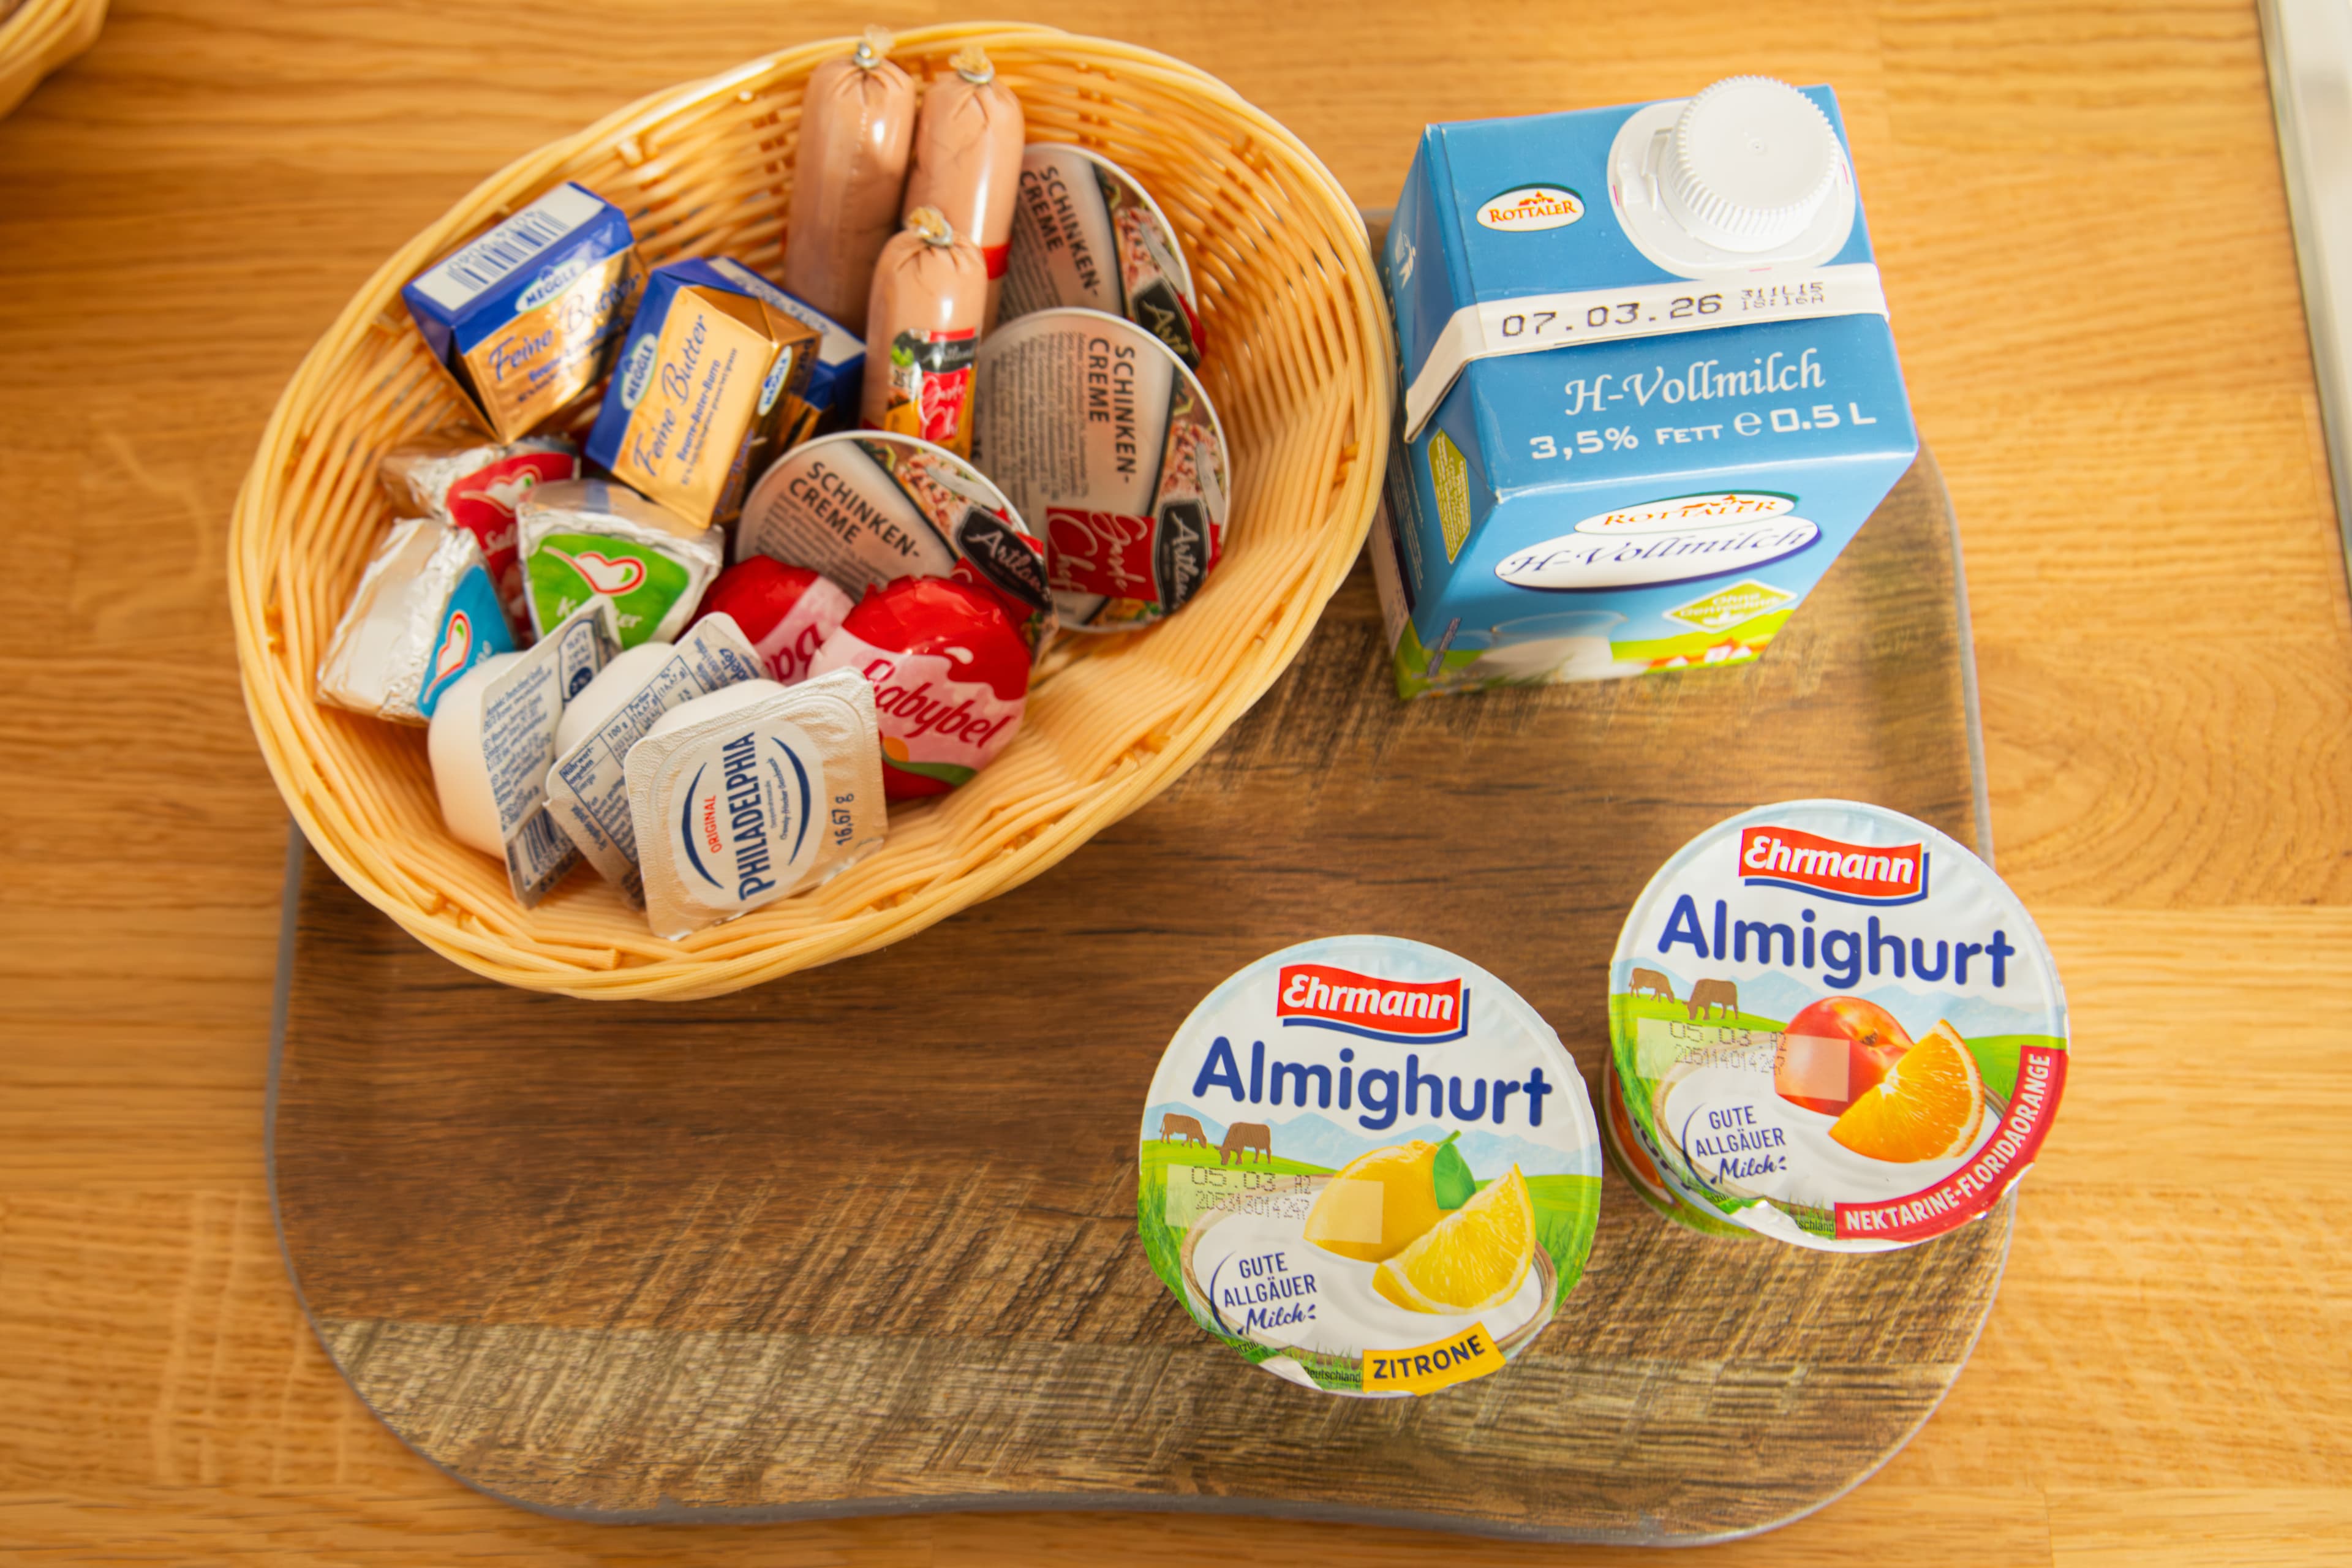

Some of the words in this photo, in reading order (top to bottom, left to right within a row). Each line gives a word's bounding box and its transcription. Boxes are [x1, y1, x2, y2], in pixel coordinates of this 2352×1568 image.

[1022, 170, 1064, 252] CREME
[1502, 293, 1724, 337] 07.03.26
[488, 329, 554, 381] Feine
[627, 343, 655, 401] MEGGLE
[1088, 337, 1110, 424] CREME
[1564, 347, 1826, 417] H-Vollmilch
[633, 407, 677, 477] Feine
[661, 314, 707, 407] Butter
[1114, 344, 1137, 485] SCHINKEN-
[1529, 426, 1639, 461] 3,5%
[1770, 404, 1841, 432] 0.5
[1849, 402, 1877, 425] L
[788, 478, 861, 546] CREME
[805, 461, 922, 559] SCHINKEN-
[1501, 524, 1817, 576] H-Vollmilch
[862, 658, 1016, 748] Babybel
[704, 794, 723, 854] ORIGINAL
[723, 731, 777, 901] PHILADELPHIA
[832, 809, 853, 846] 16,67
[835, 793, 855, 804] g
[1743, 835, 1916, 885] Ehrmann
[1657, 894, 2015, 989] Almighurt
[1282, 973, 1455, 1020] Ehrmann
[1192, 1035, 1553, 1131] Almighurt
[1695, 1127, 1786, 1158] ALLGÄUER
[1708, 1105, 1757, 1130] GUTE
[1844, 1053, 2051, 1231] NEKTARINE-FLORIDAORANGE
[1719, 1154, 1777, 1185] Milch
[1224, 1273, 1318, 1308] ALLGÄUER
[1238, 1251, 1289, 1279] GUTE
[1245, 1302, 1307, 1335] Milch
[1373, 1334, 1486, 1381] ZITRONE
